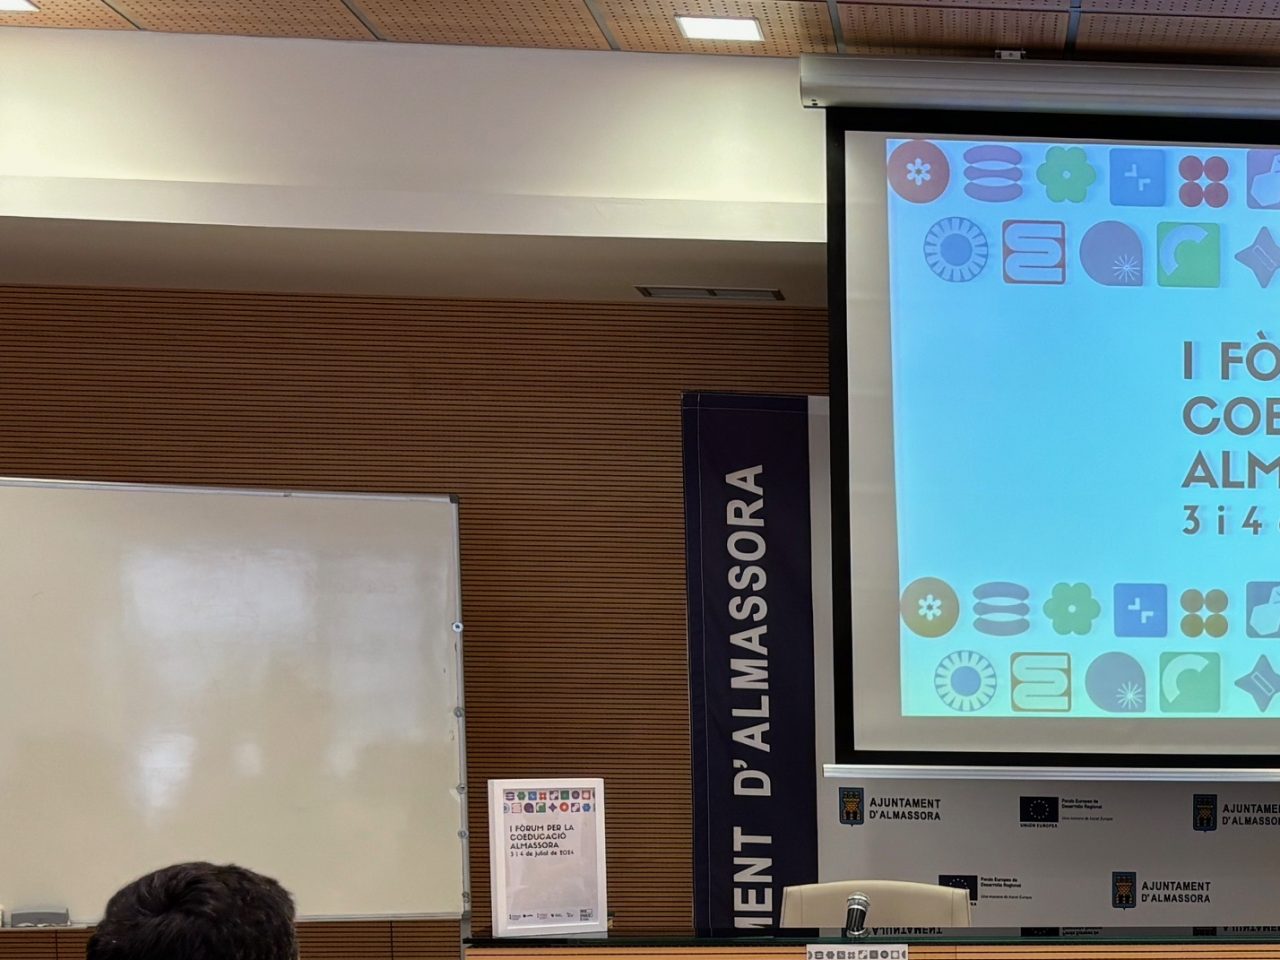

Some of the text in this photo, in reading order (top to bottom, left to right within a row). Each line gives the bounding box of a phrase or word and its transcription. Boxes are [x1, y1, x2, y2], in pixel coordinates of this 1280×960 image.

[1182, 340, 1194, 380] I
[1182, 505, 1201, 536] 3
[1216, 505, 1226, 536] i
[1241, 506, 1264, 537] 4
[725, 464, 772, 798] D'ALMASSORA
[869, 797, 941, 809] AJUNTAMENT
[869, 809, 941, 820] D'ALMASSORA
[546, 824, 562, 832] PER
[564, 823, 575, 831] LA
[510, 831, 567, 841] COEDUCACIÓ
[509, 841, 560, 850] ALMASSORA
[1141, 881, 1212, 891] AJUNTAMENT
[1141, 893, 1211, 903] D'ALMASSORA
